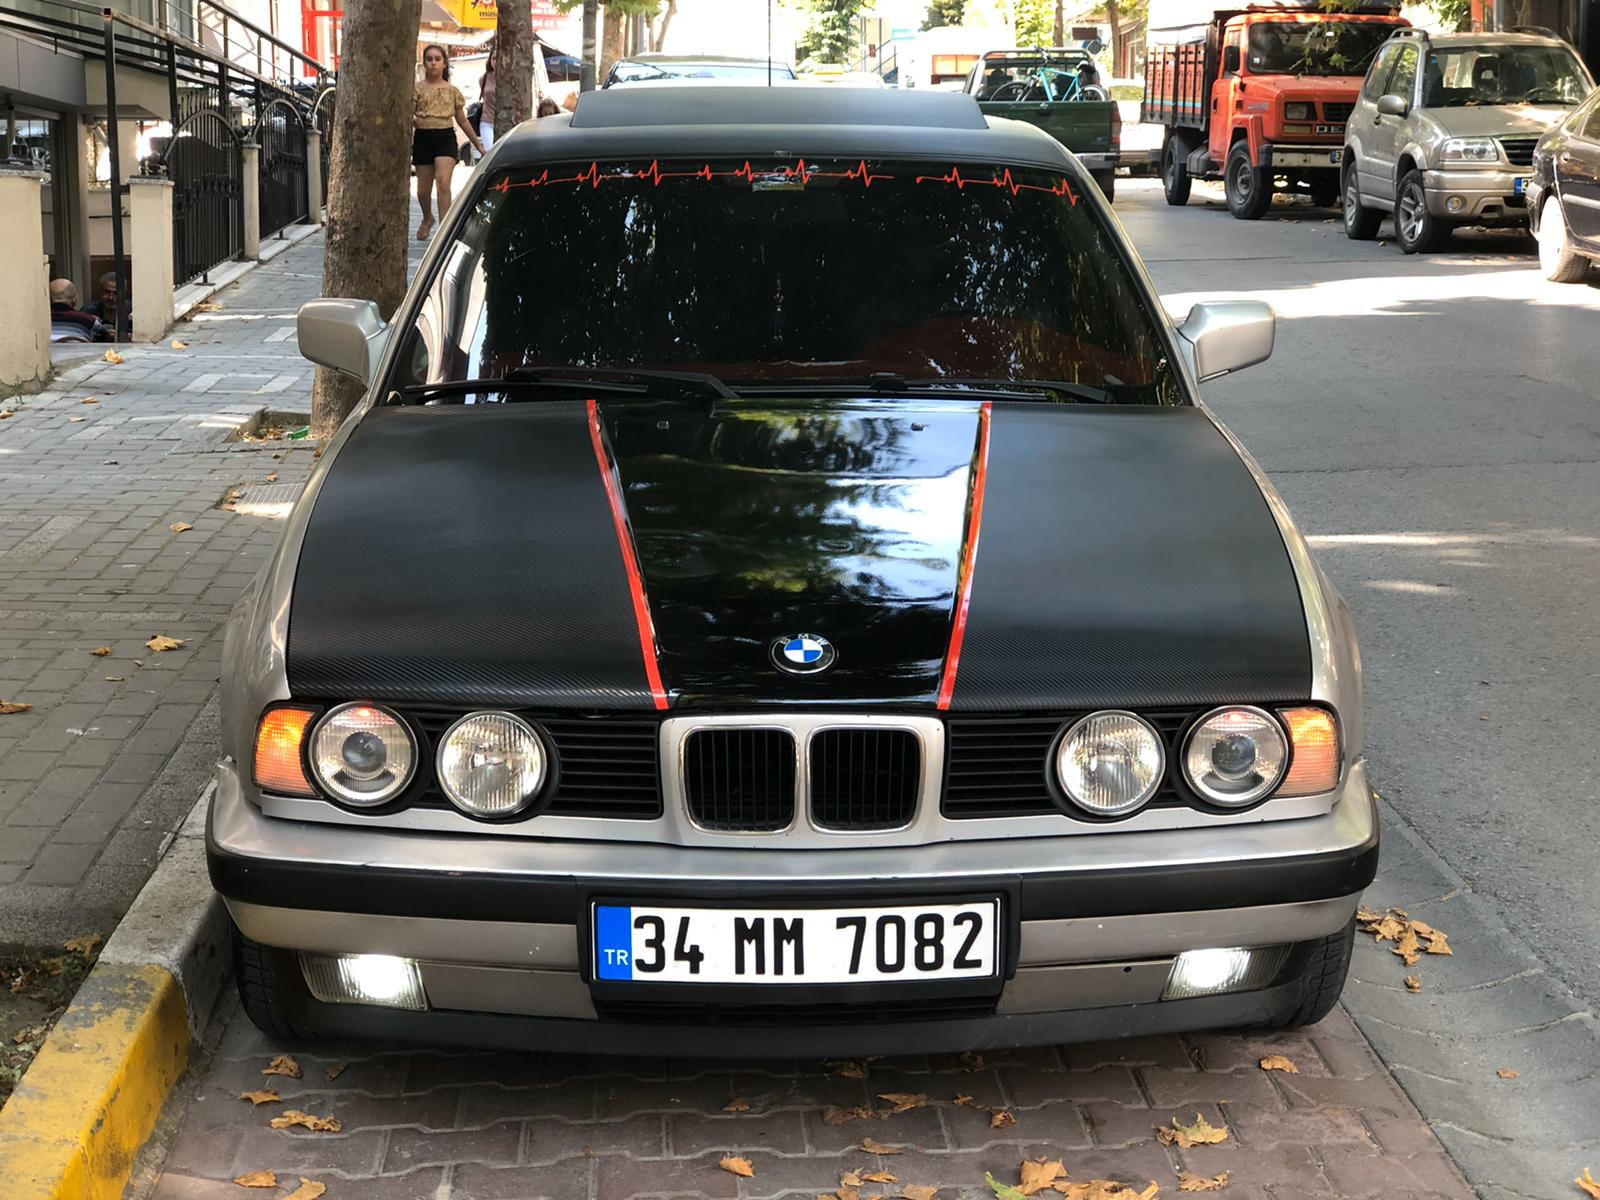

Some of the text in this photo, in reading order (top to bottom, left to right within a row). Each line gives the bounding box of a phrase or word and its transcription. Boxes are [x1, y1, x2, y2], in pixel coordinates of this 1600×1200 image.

[779, 633, 829, 645] BMW
[603, 911, 983, 975] TR 34 MM 7082
